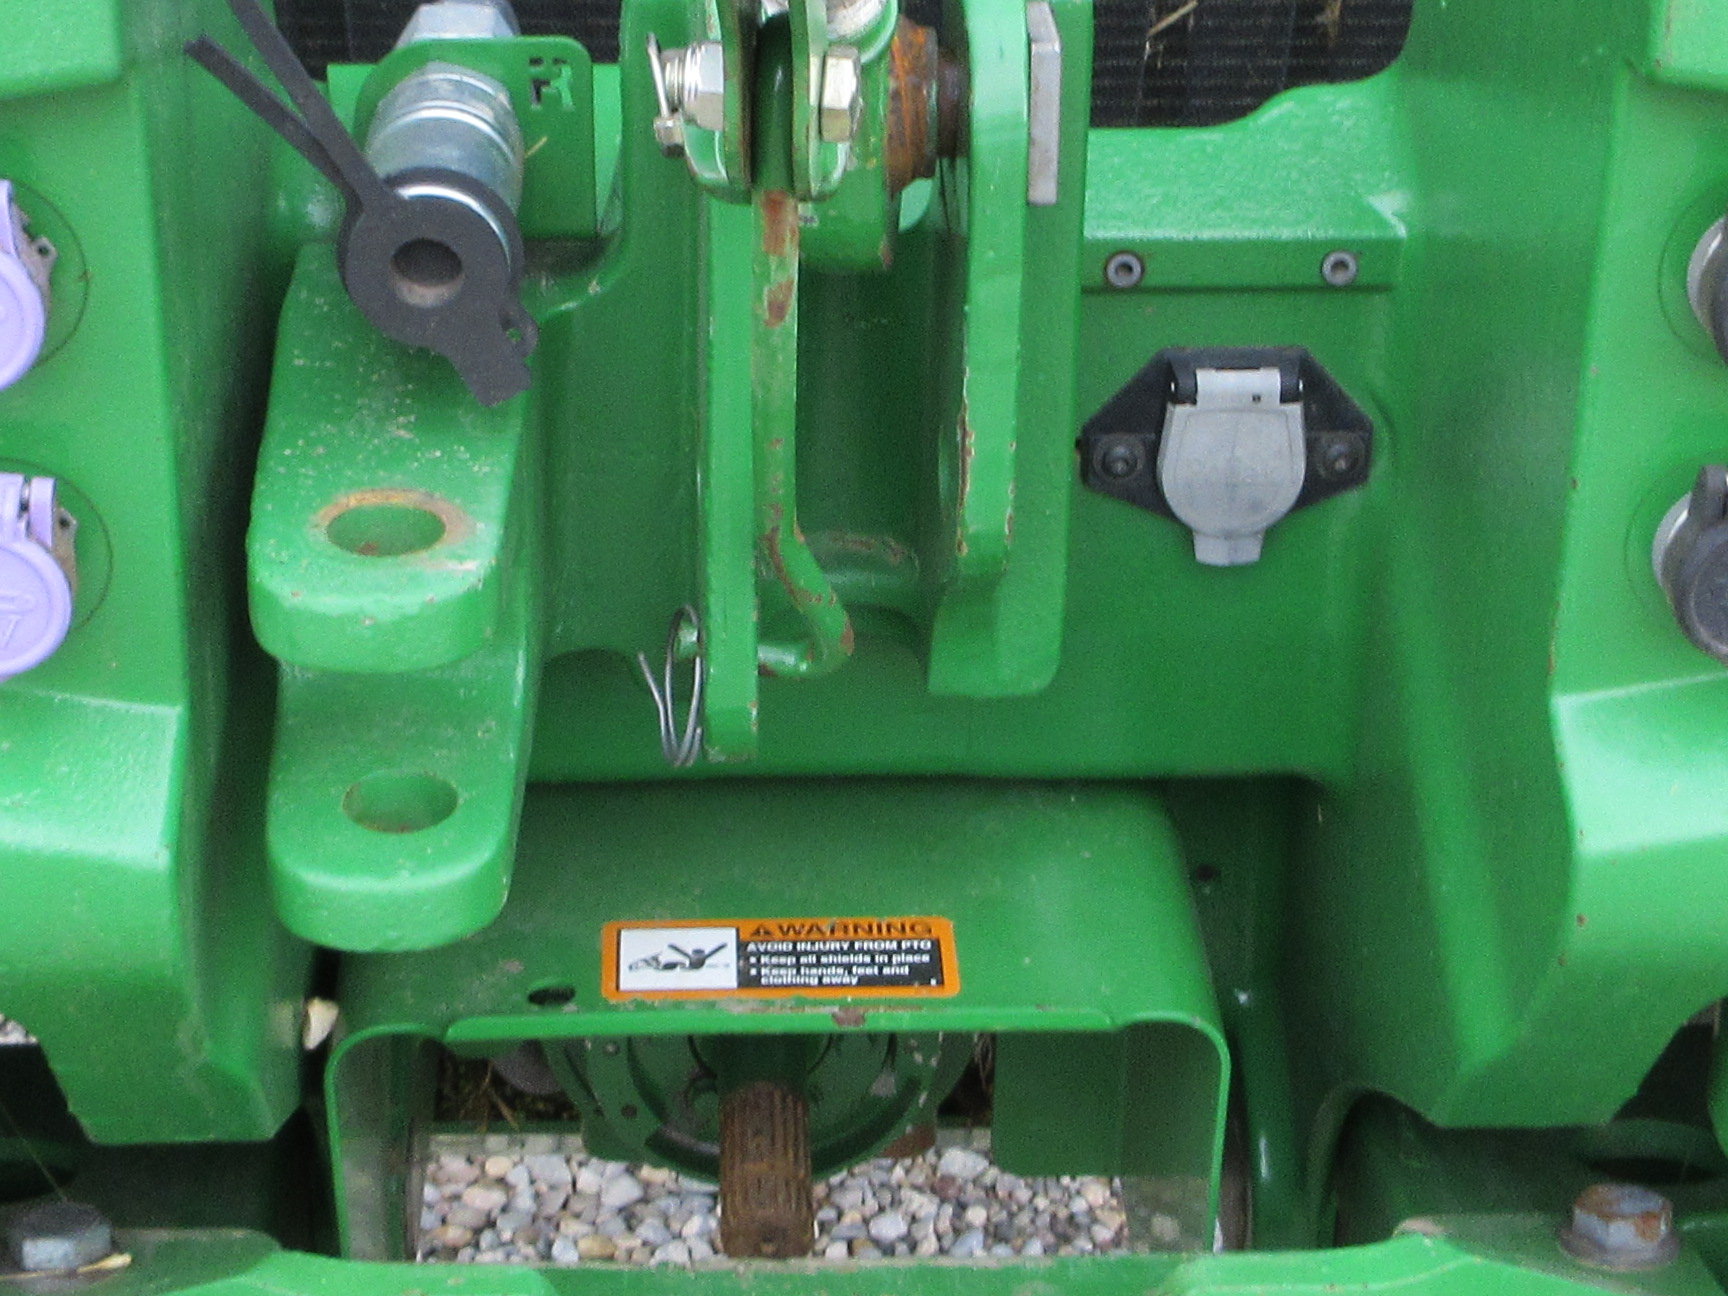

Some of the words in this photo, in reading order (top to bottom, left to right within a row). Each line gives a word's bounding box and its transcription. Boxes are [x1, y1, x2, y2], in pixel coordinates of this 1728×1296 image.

[777, 920, 932, 937] WARNING
[747, 941, 793, 953] AVOID
[796, 940, 851, 952] INJURY
[854, 940, 898, 951] FROM
[901, 939, 932, 951] PTO
[760, 954, 796, 966] Keep
[800, 953, 817, 965] all
[820, 953, 872, 964] shields
[875, 953, 889, 964] in
[892, 952, 931, 965] place
[760, 967, 797, 979] Keep
[852, 965, 879, 977] feet
[882, 965, 910, 976] and
[760, 975, 818, 987] clothing
[822, 975, 859, 986] away
